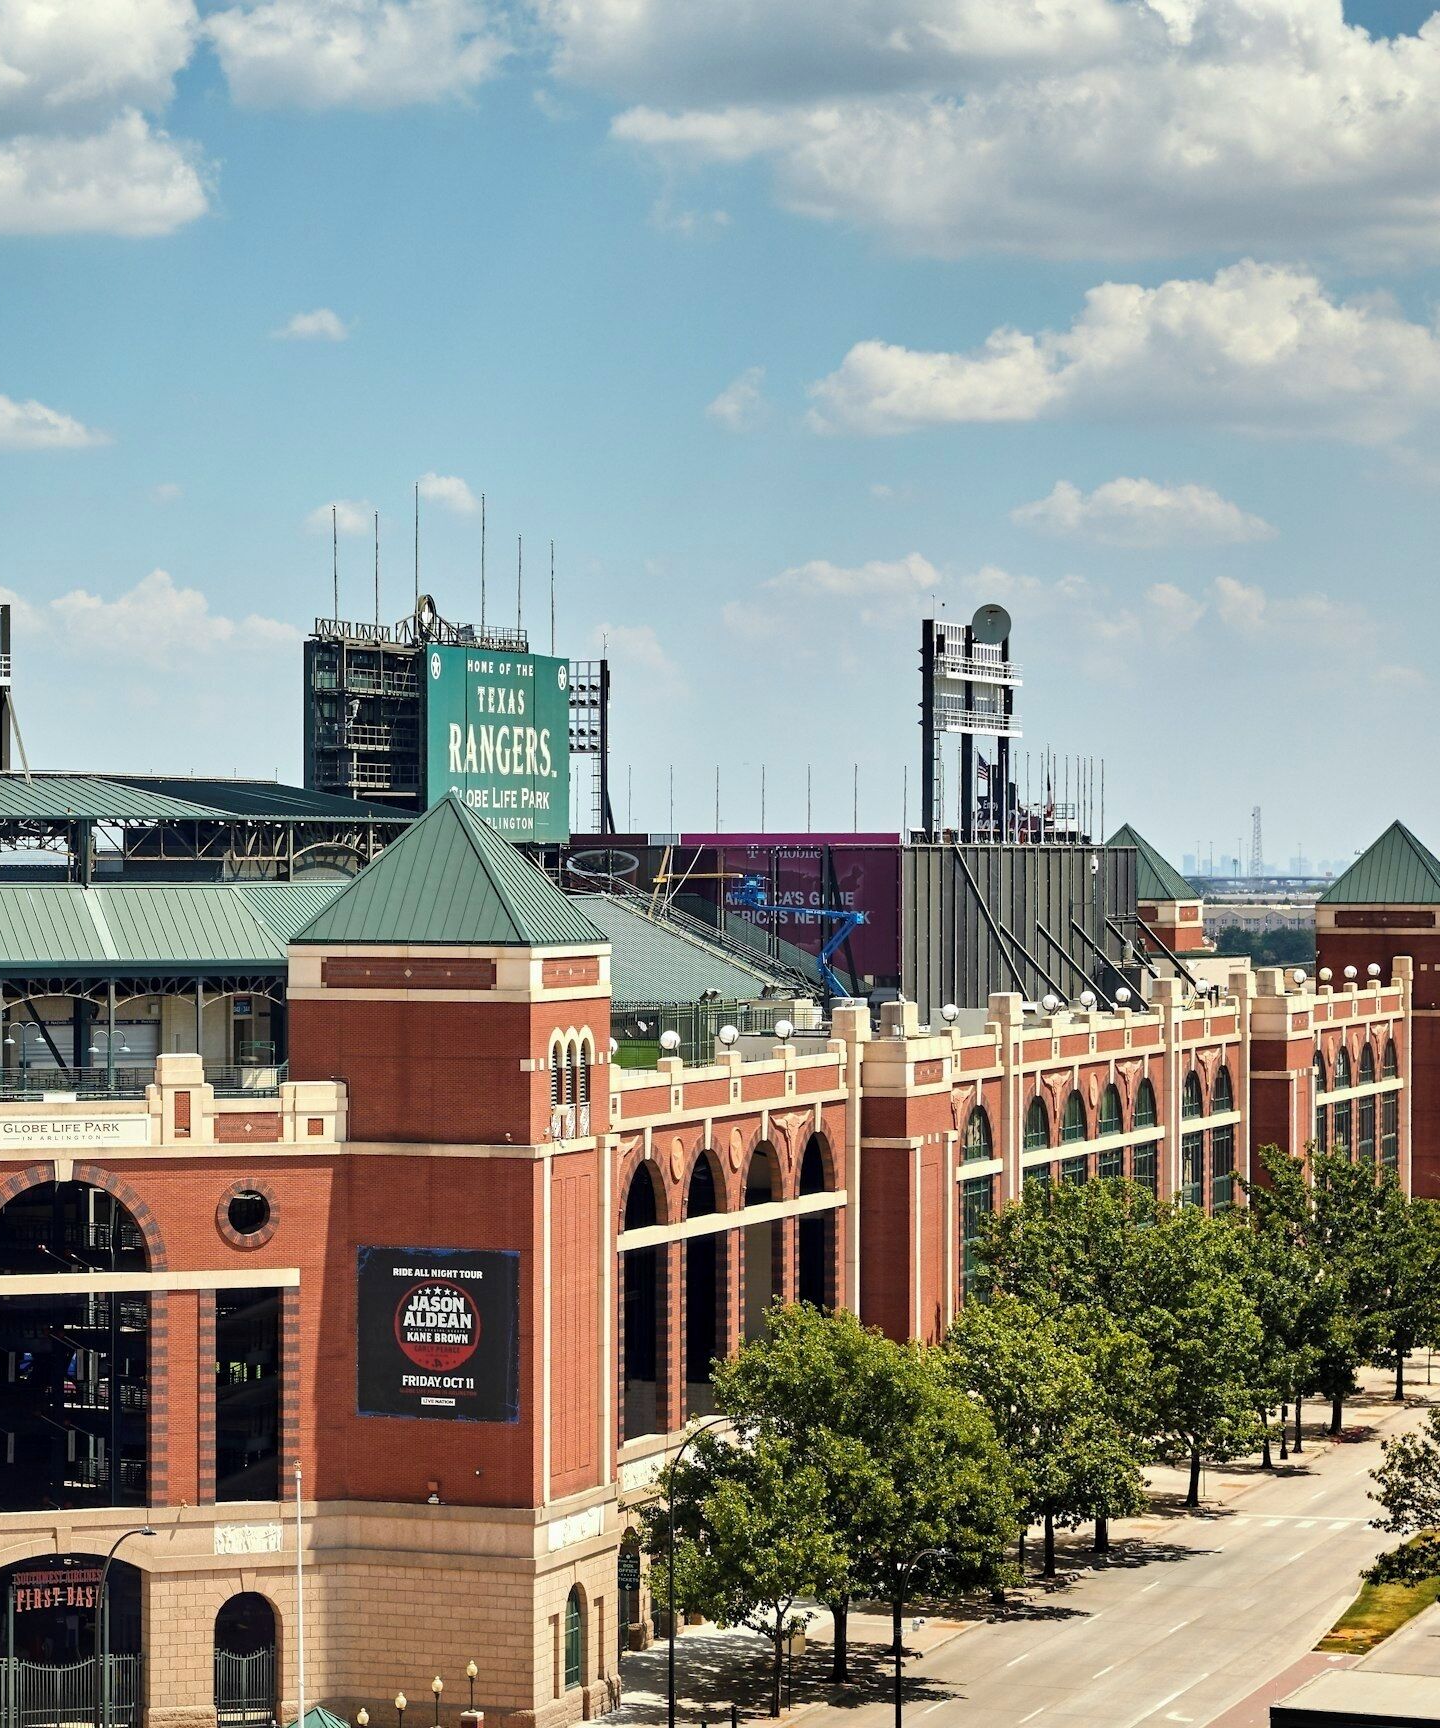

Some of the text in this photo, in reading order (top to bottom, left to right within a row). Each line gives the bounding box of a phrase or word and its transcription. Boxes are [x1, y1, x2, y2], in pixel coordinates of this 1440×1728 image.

[467, 660, 534, 677] HOME OF THE
[477, 685, 525, 716] TEXAS
[449, 722, 551, 778] RANGERS
[3, 1122, 120, 1133] GLOBE LIFE PARK
[393, 1268, 483, 1279] RIDE ALL NIGHT TOUR
[408, 1295, 465, 1313] JASON
[403, 1312, 472, 1329] ALDEAN
[407, 1332, 468, 1344] KANE BROWN
[443, 1377, 464, 1388] OCT
[466, 1378, 474, 1389] 11
[16, 1571, 63, 1585] SOUTHWEST
[16, 1587, 60, 1612] FIRST
